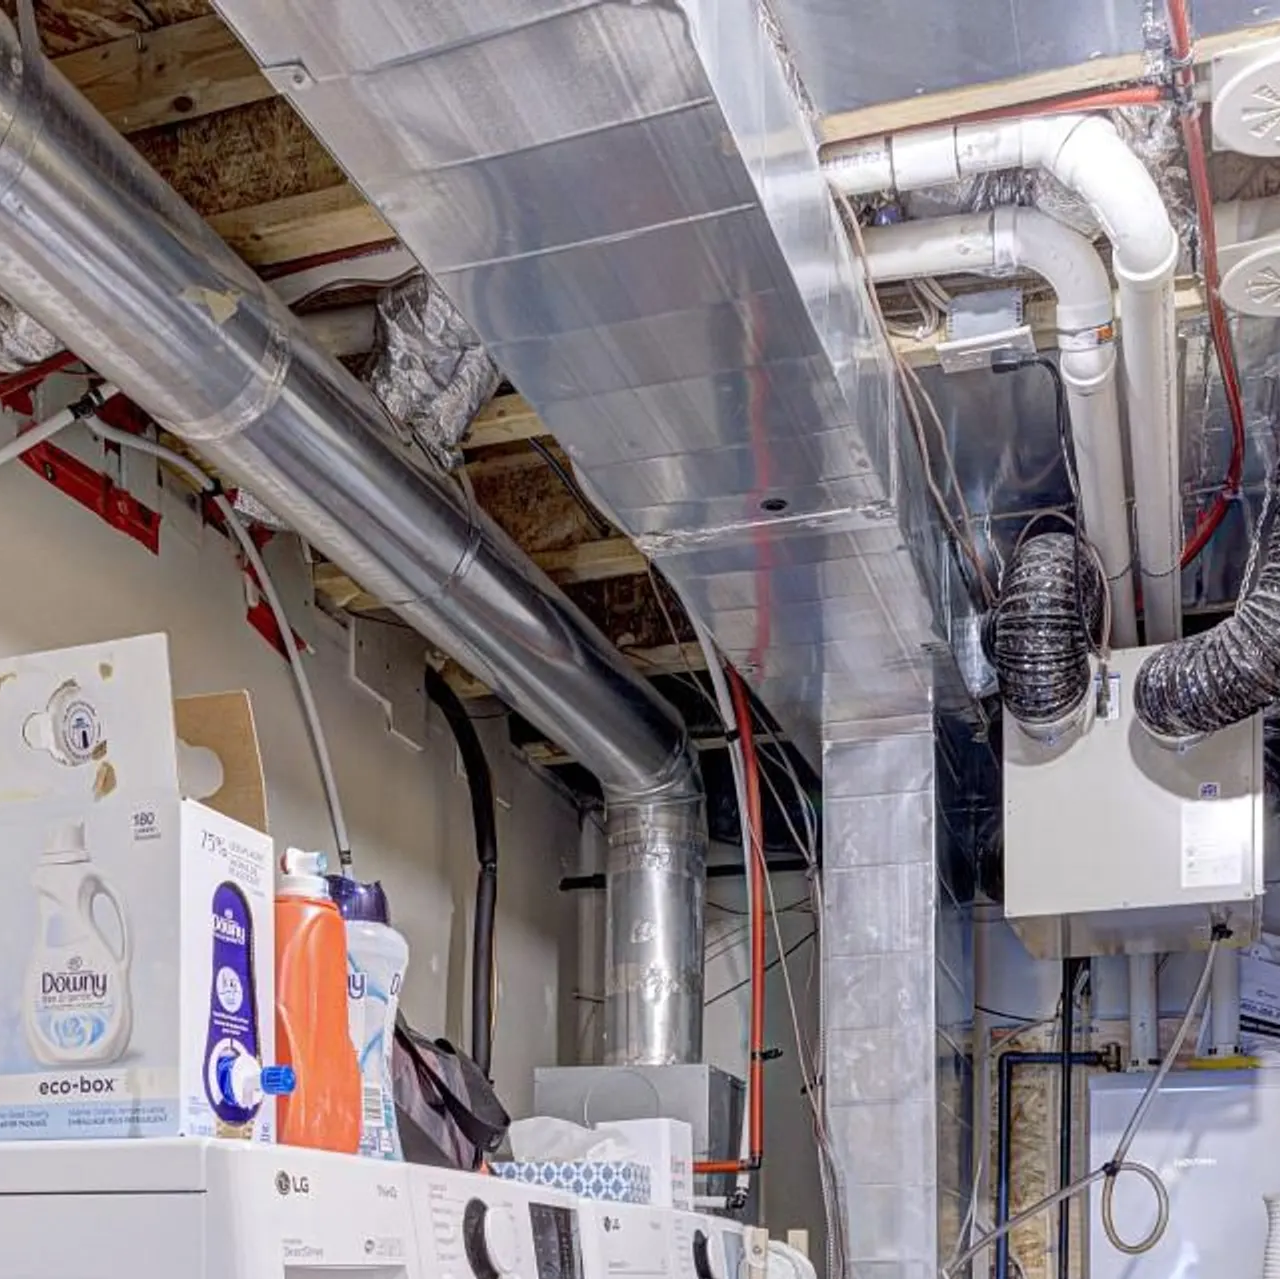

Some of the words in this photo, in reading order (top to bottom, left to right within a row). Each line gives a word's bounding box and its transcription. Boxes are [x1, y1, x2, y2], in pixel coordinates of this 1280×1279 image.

[133, 811, 155, 826] 180
[41, 971, 108, 998] Downy
[39, 1075, 116, 1095] eco-box
